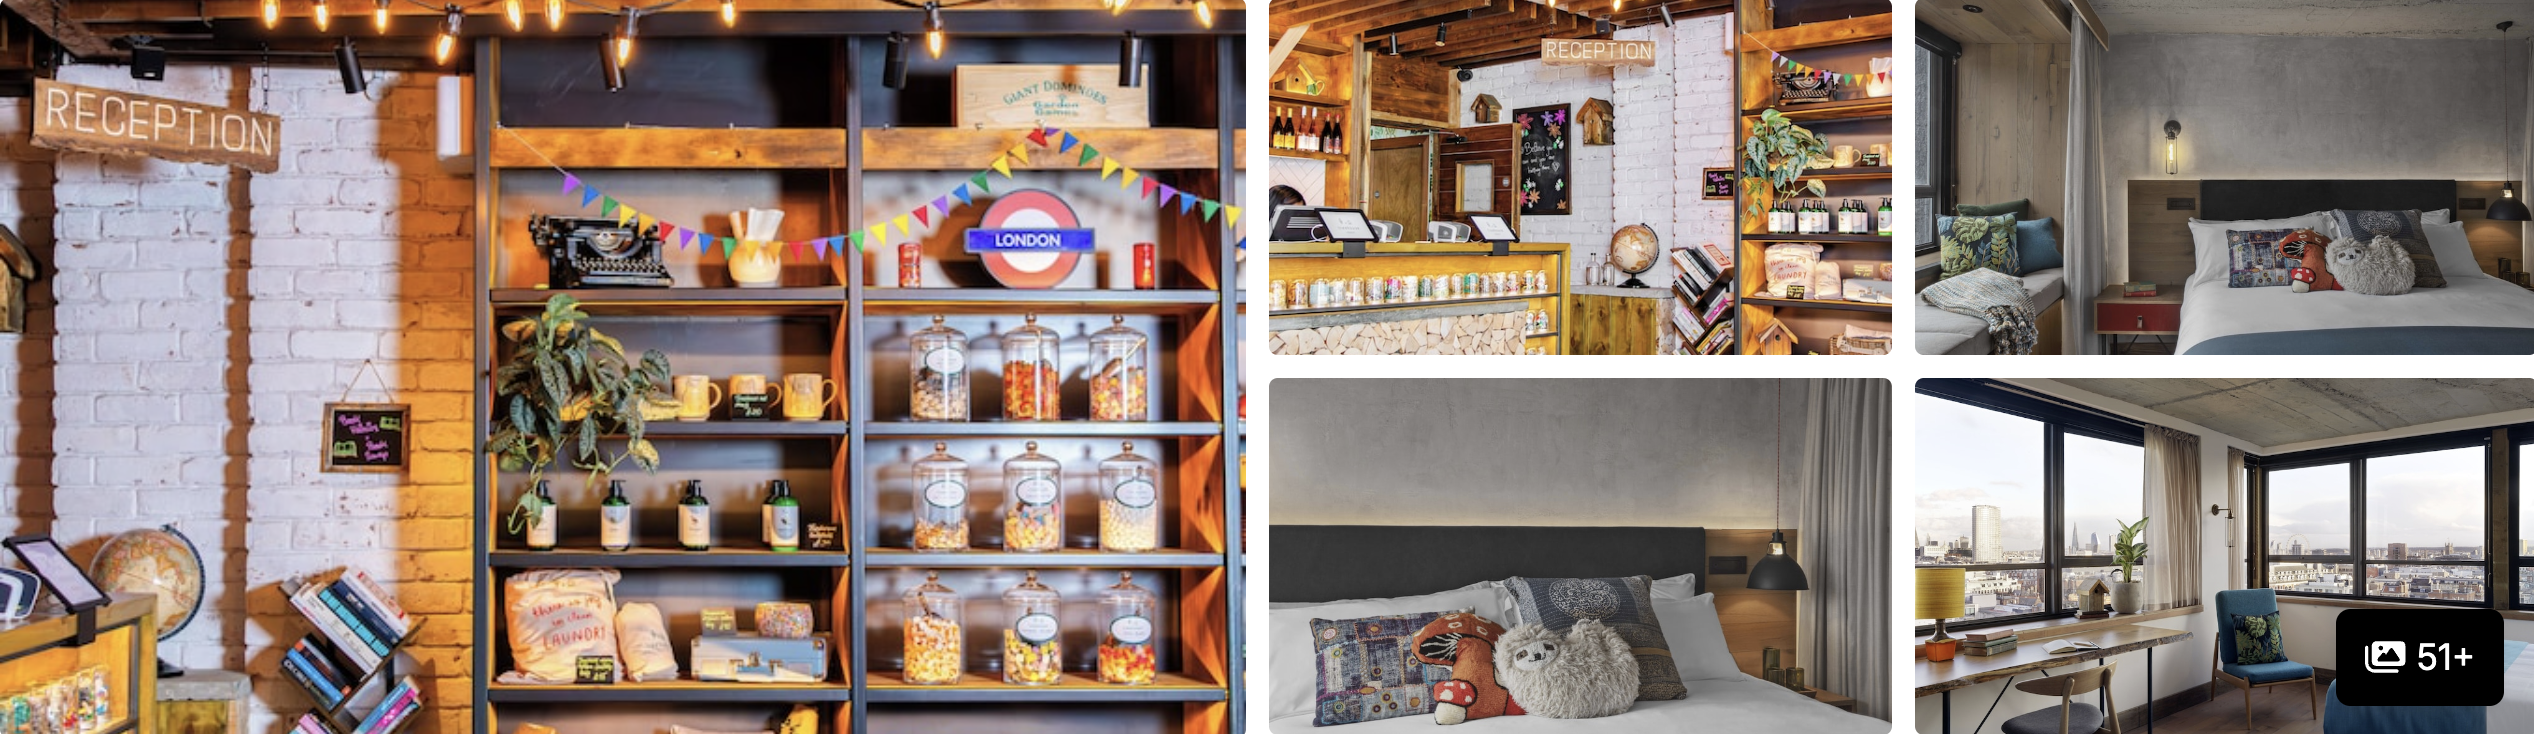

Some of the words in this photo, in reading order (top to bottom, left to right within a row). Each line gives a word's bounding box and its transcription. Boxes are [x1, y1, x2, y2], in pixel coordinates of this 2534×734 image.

[1546, 41, 1652, 60] RECEPTION
[1002, 83, 1040, 105] GIANT
[1043, 80, 1108, 105] DOMINOES
[46, 87, 272, 157] RECEPTION
[995, 233, 1062, 248] LONDON
[1773, 270, 1807, 283] LAUNDRY
[543, 626, 606, 649] LAUNDRY
